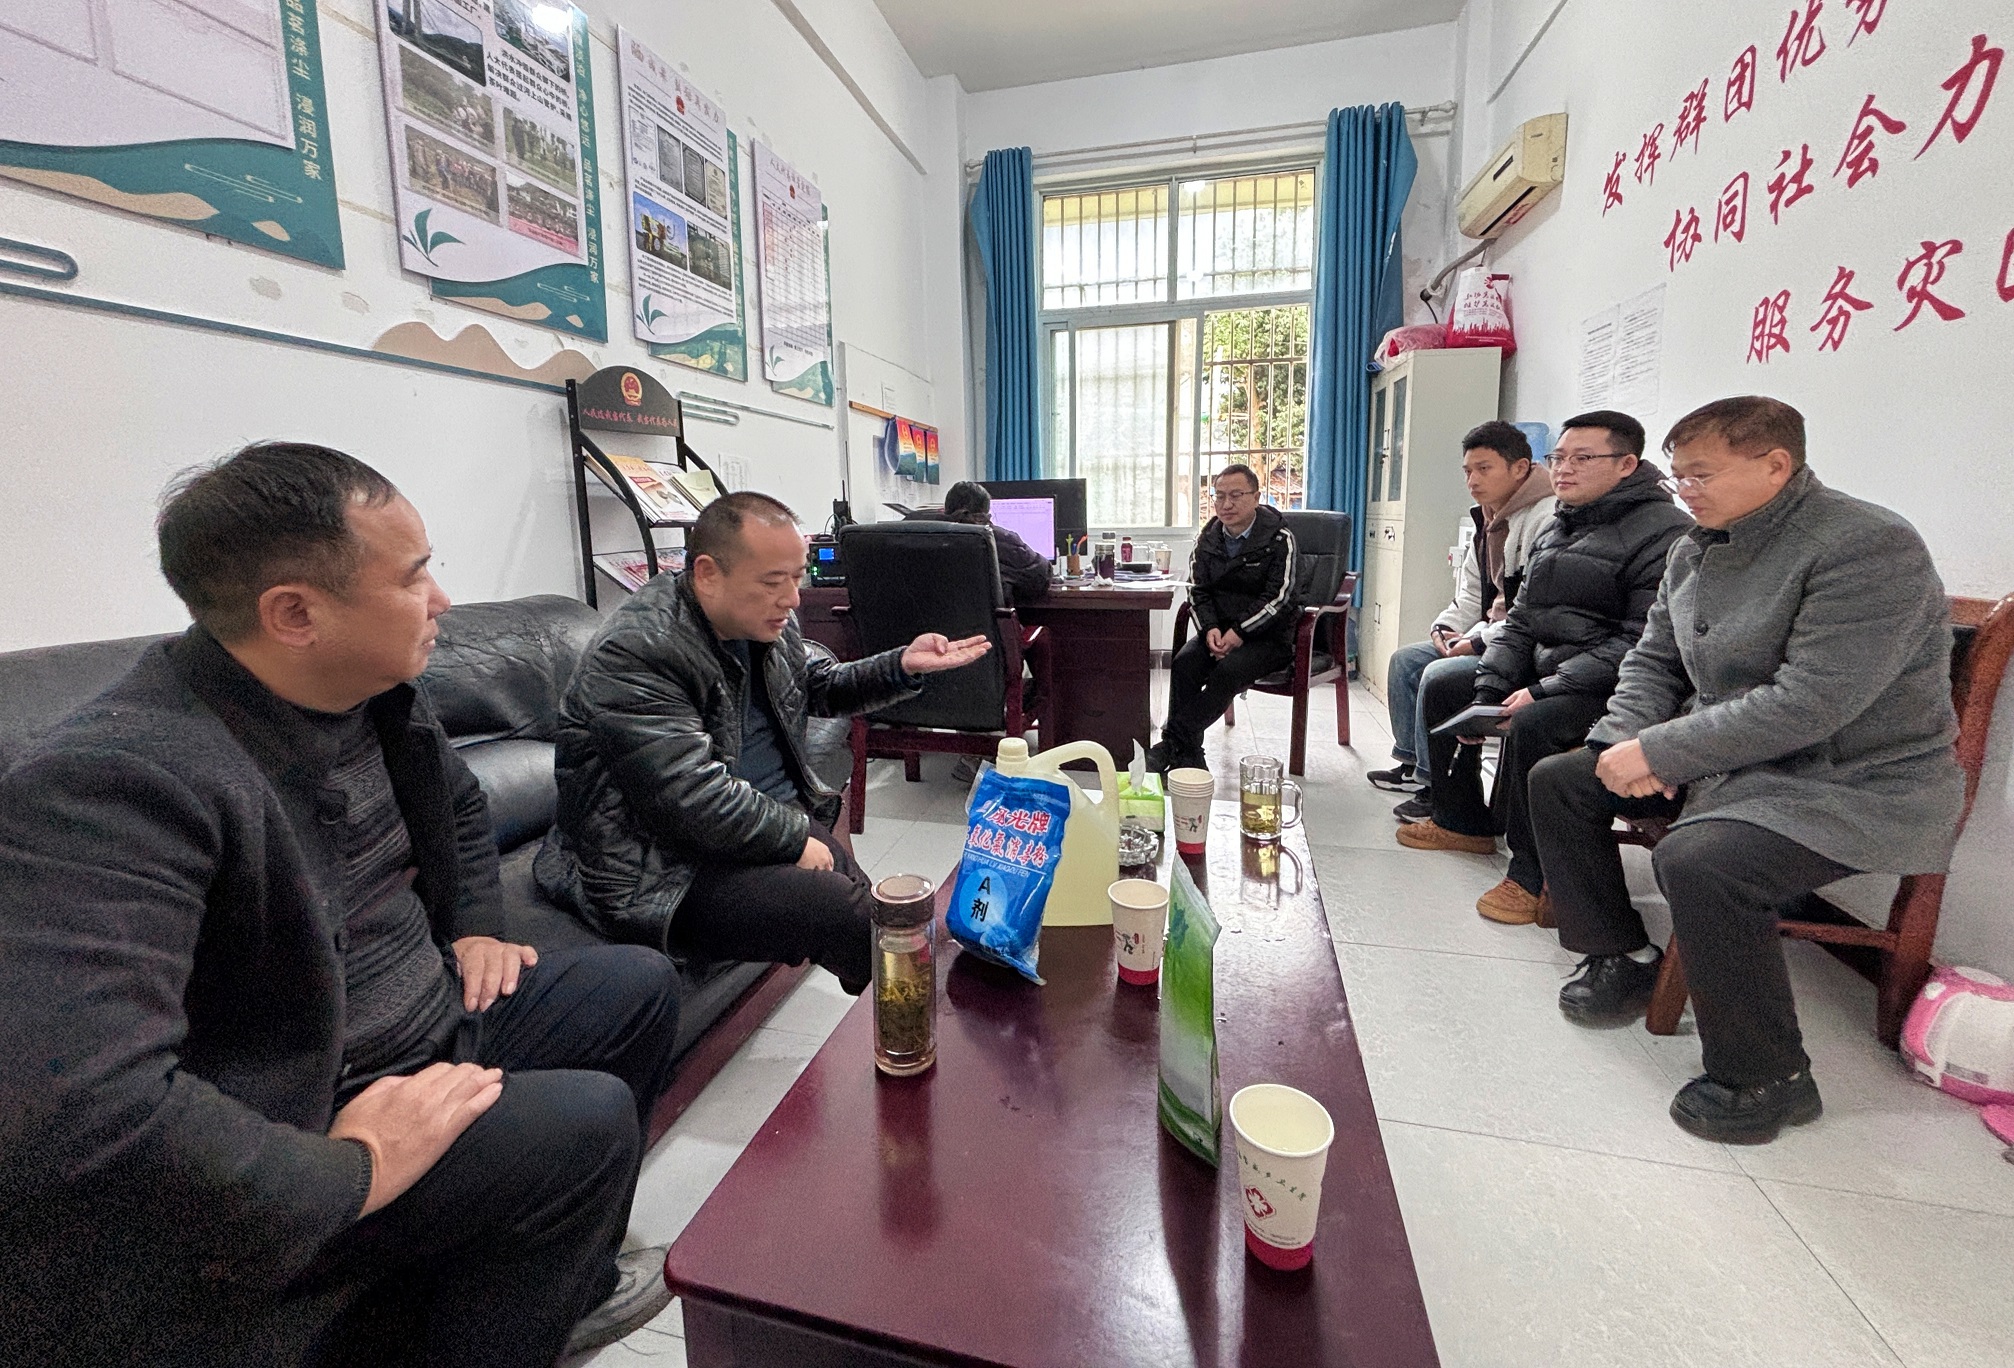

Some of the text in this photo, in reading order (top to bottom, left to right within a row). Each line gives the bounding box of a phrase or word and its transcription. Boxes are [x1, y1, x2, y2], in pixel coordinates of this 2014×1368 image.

[1663, 34, 2005, 273] 协同社会力
[1747, 228, 2014, 364] 服务灾
[966, 823, 1049, 868] 氧化氯消毒粉
